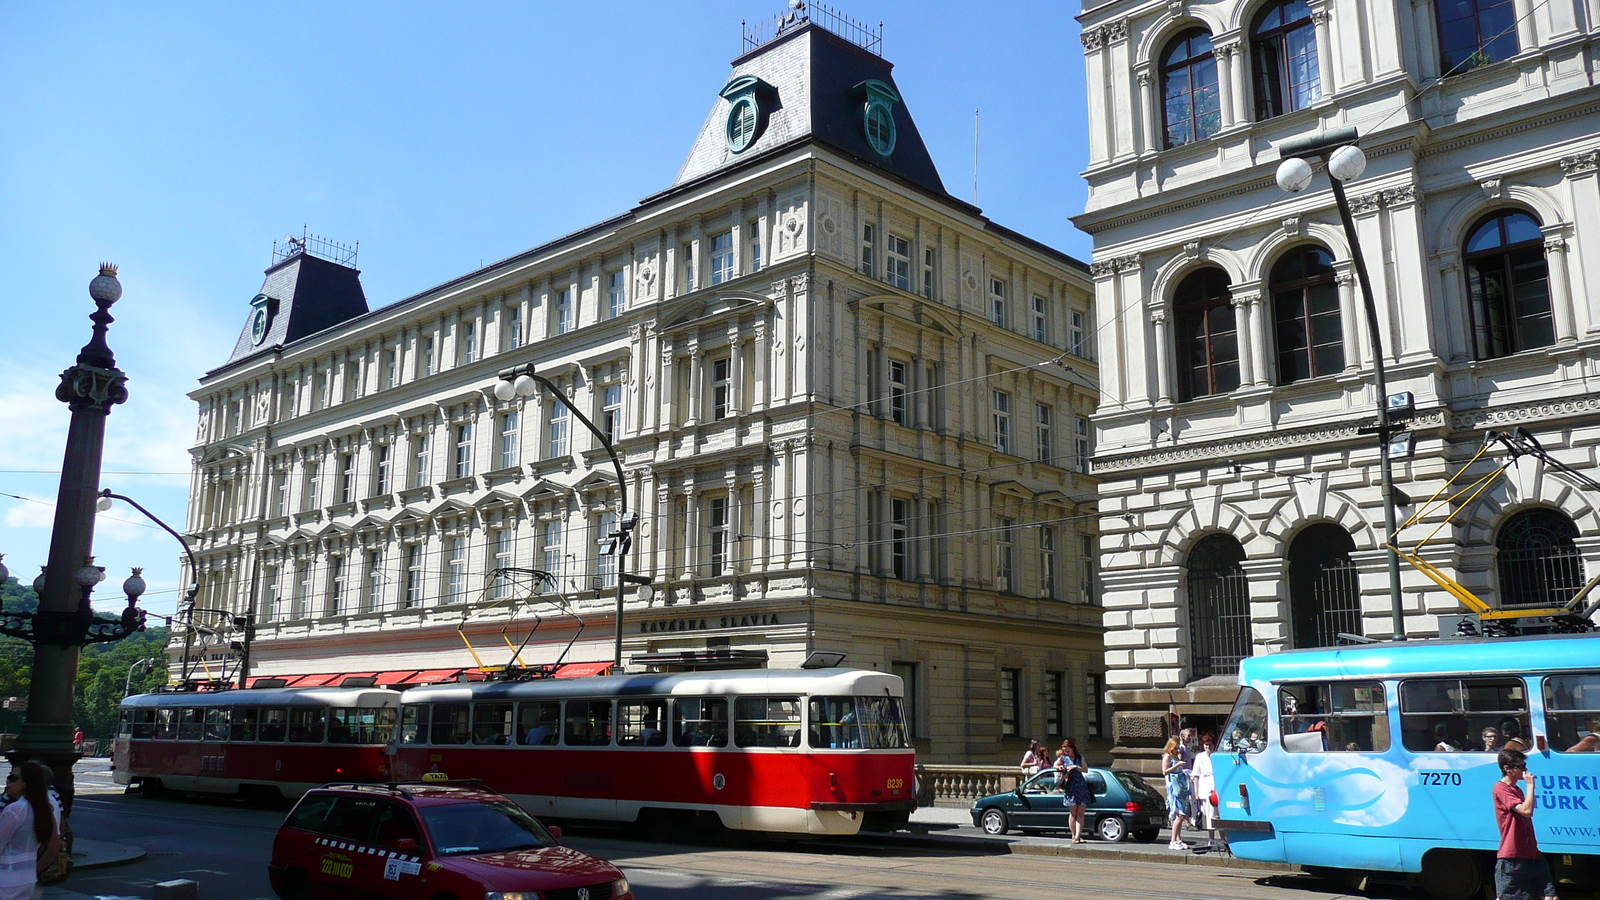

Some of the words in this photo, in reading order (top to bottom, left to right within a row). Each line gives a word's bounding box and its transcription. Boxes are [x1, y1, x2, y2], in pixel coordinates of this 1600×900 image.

[640, 619, 707, 633] KAVÁRNA
[720, 614, 779, 628] SLAVIA
[887, 778, 903, 789] 8239
[1420, 772, 1462, 786] 7270
